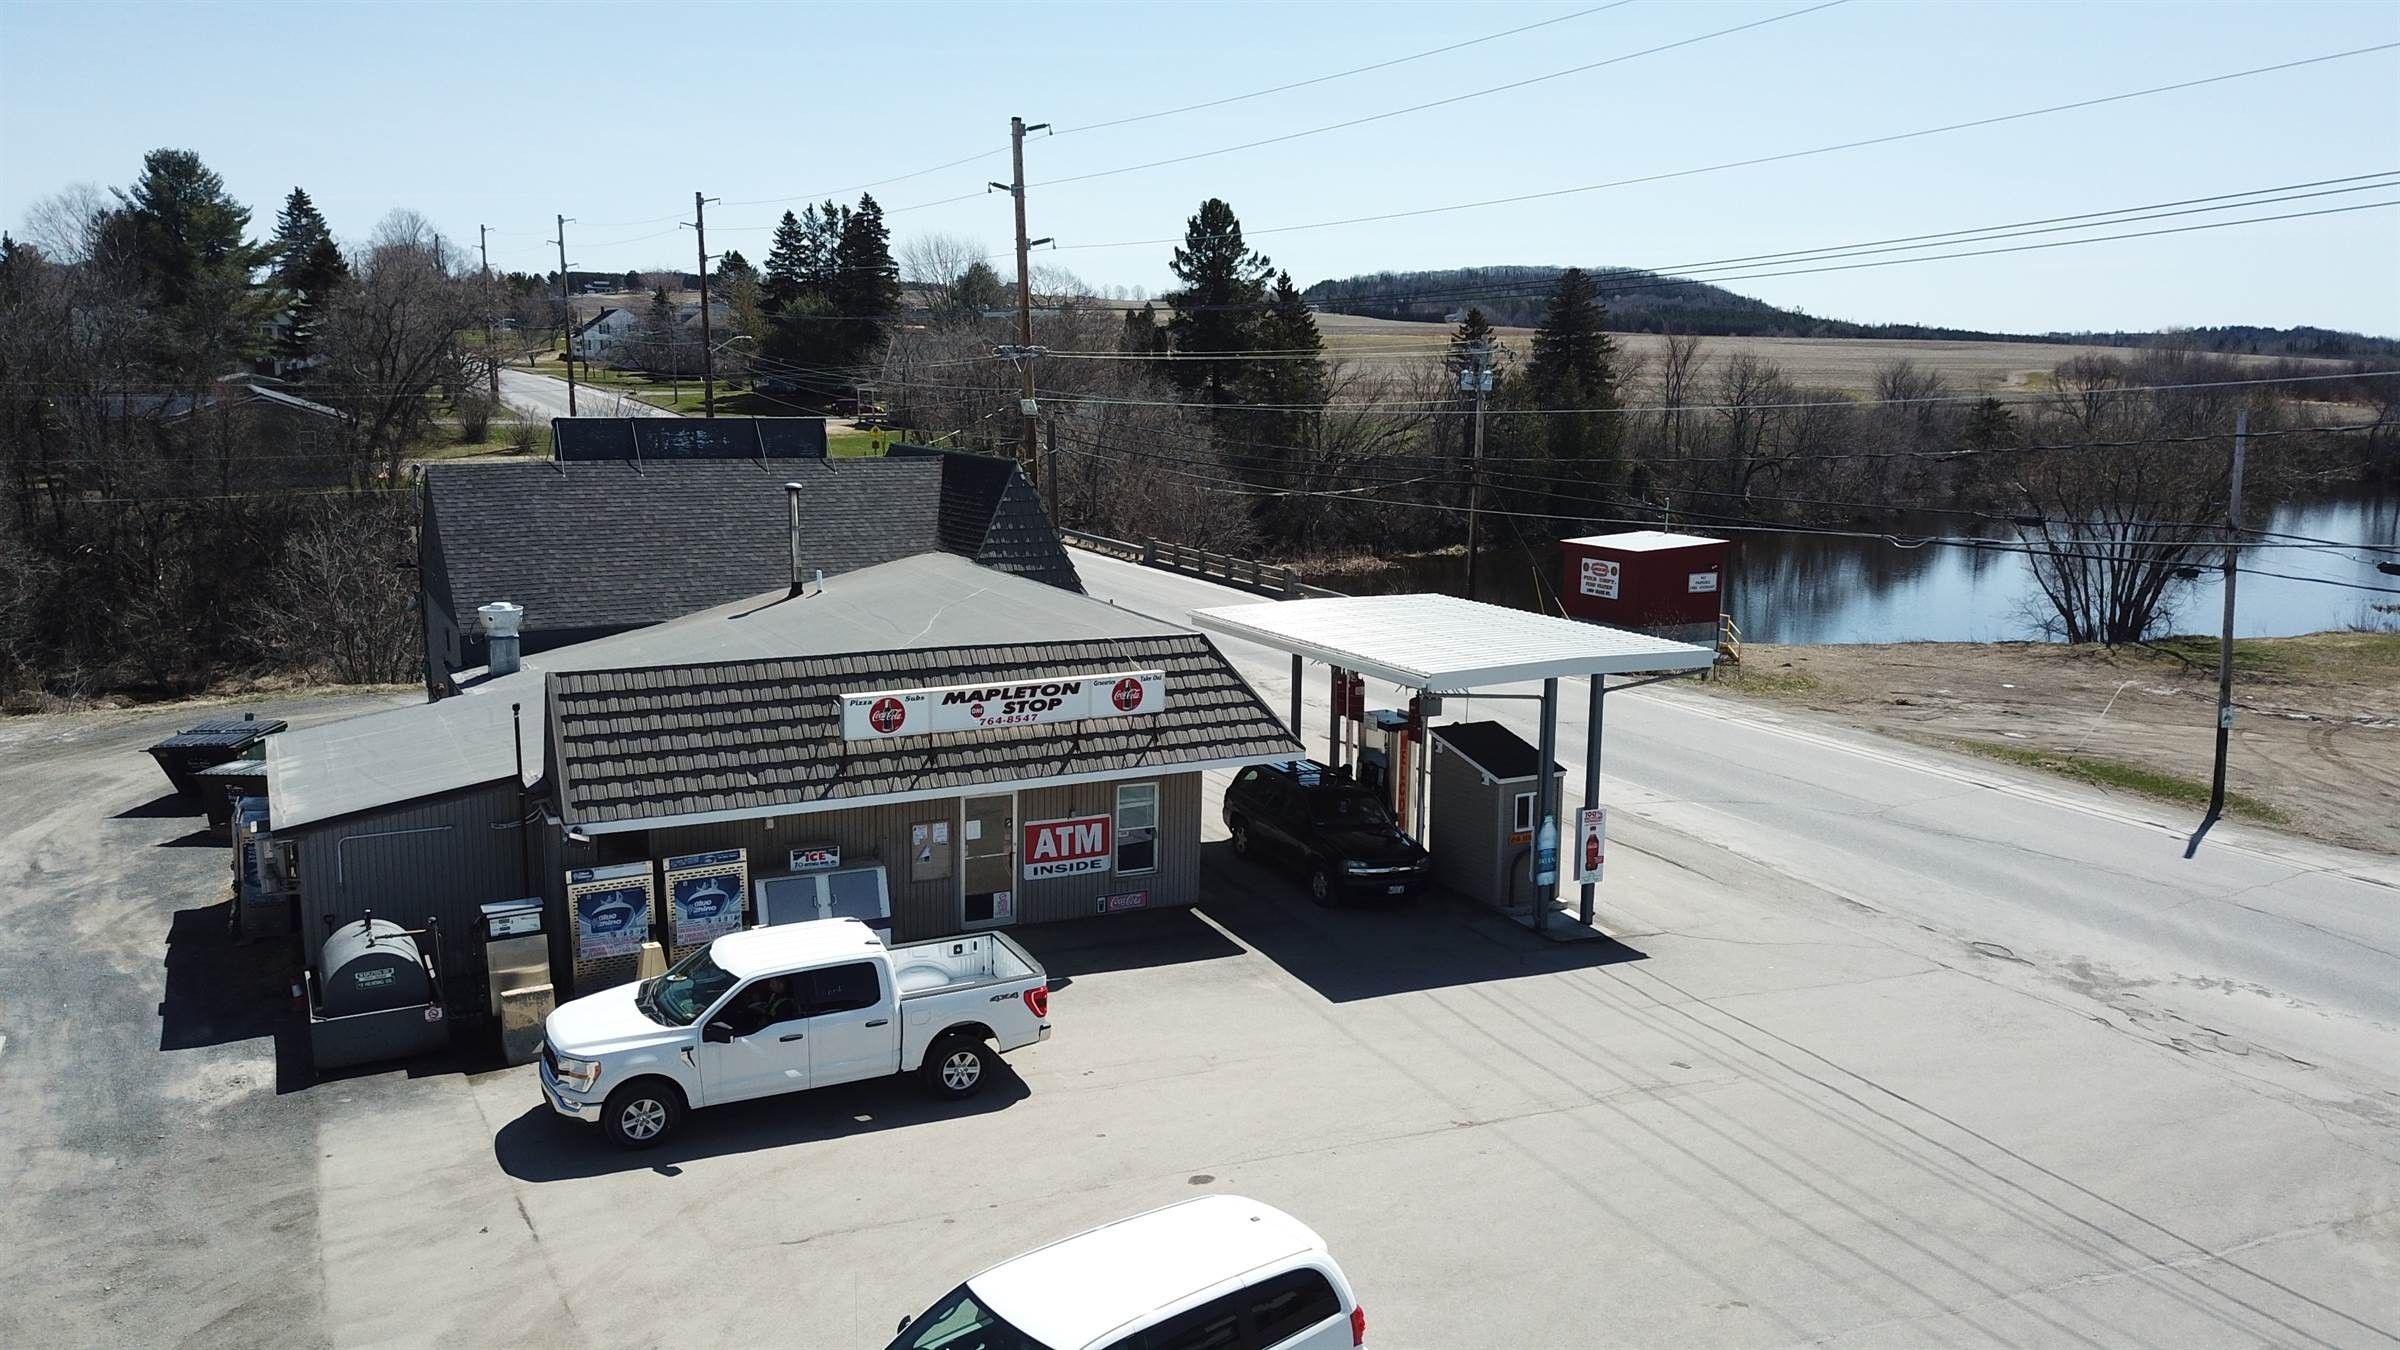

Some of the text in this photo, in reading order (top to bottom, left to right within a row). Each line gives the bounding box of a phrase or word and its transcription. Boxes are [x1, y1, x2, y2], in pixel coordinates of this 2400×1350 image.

[904, 694, 925, 702] Subs
[941, 682, 1081, 705] MAPLETON
[1002, 698, 1063, 715] STOP
[979, 713, 1038, 726] 764-8547
[1033, 822, 1103, 860] ATM
[804, 851, 828, 862] ICE
[1033, 859, 1102, 876] INSIDE
